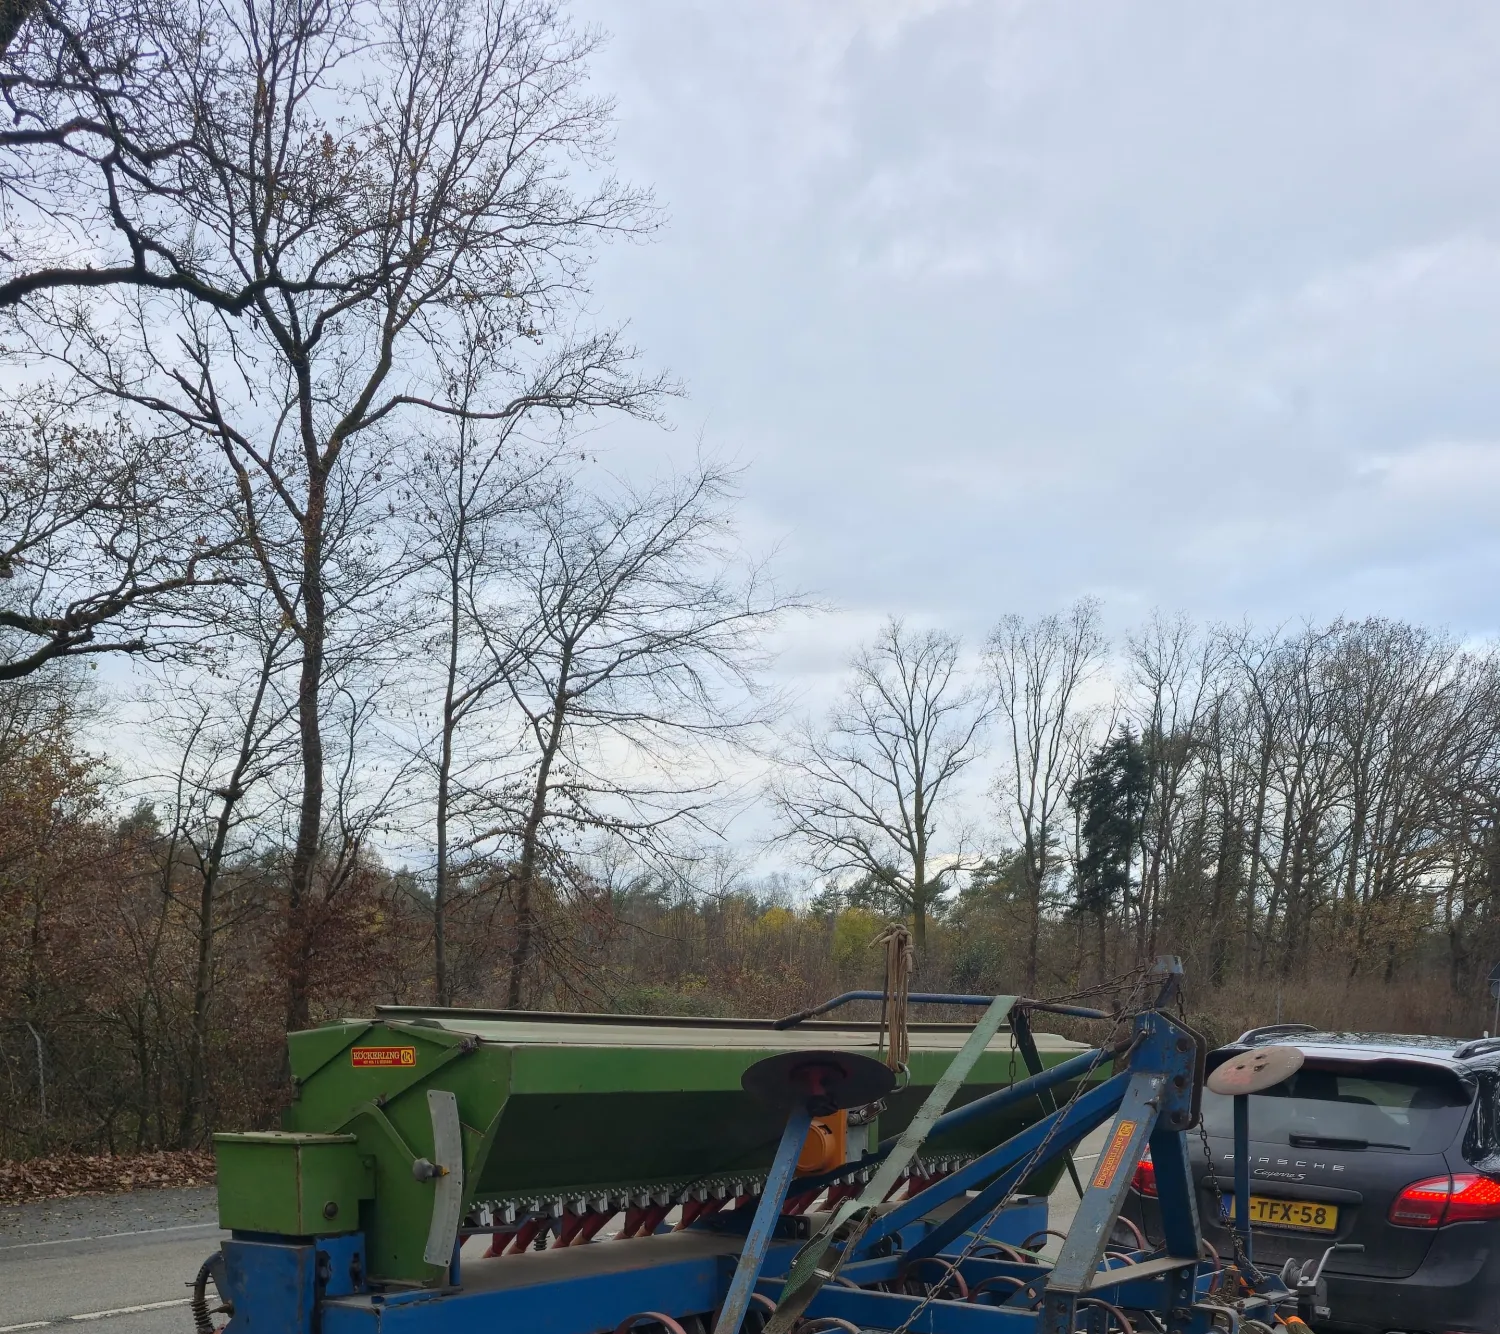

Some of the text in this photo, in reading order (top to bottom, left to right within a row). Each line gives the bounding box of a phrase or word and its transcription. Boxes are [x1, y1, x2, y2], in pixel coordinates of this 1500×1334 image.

[1223, 1154, 1345, 1171] PRSCHE
[1253, 1168, 1295, 1178] Cayenne
[1250, 1200, 1327, 1225] -TFX-58
